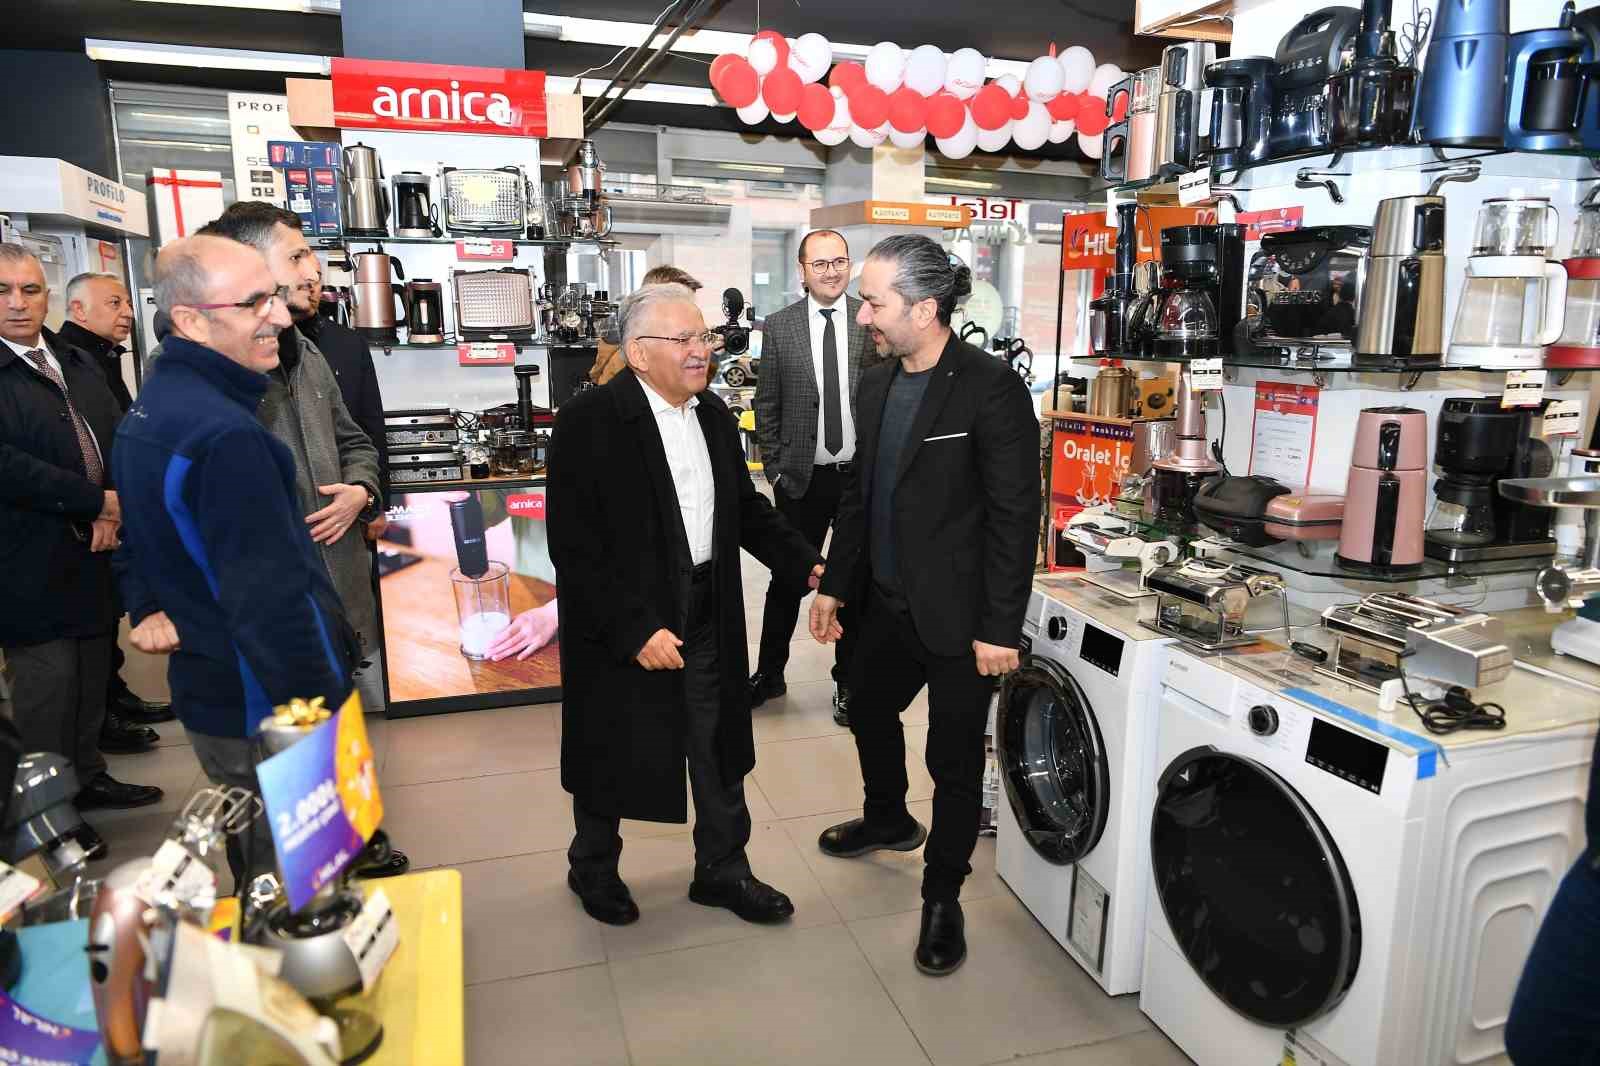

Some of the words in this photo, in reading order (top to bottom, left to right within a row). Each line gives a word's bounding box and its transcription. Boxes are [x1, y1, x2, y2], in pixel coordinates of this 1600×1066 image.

[372, 80, 512, 127] arnica
[1063, 439, 1112, 466] Oralet
[509, 499, 543, 511] arnica
